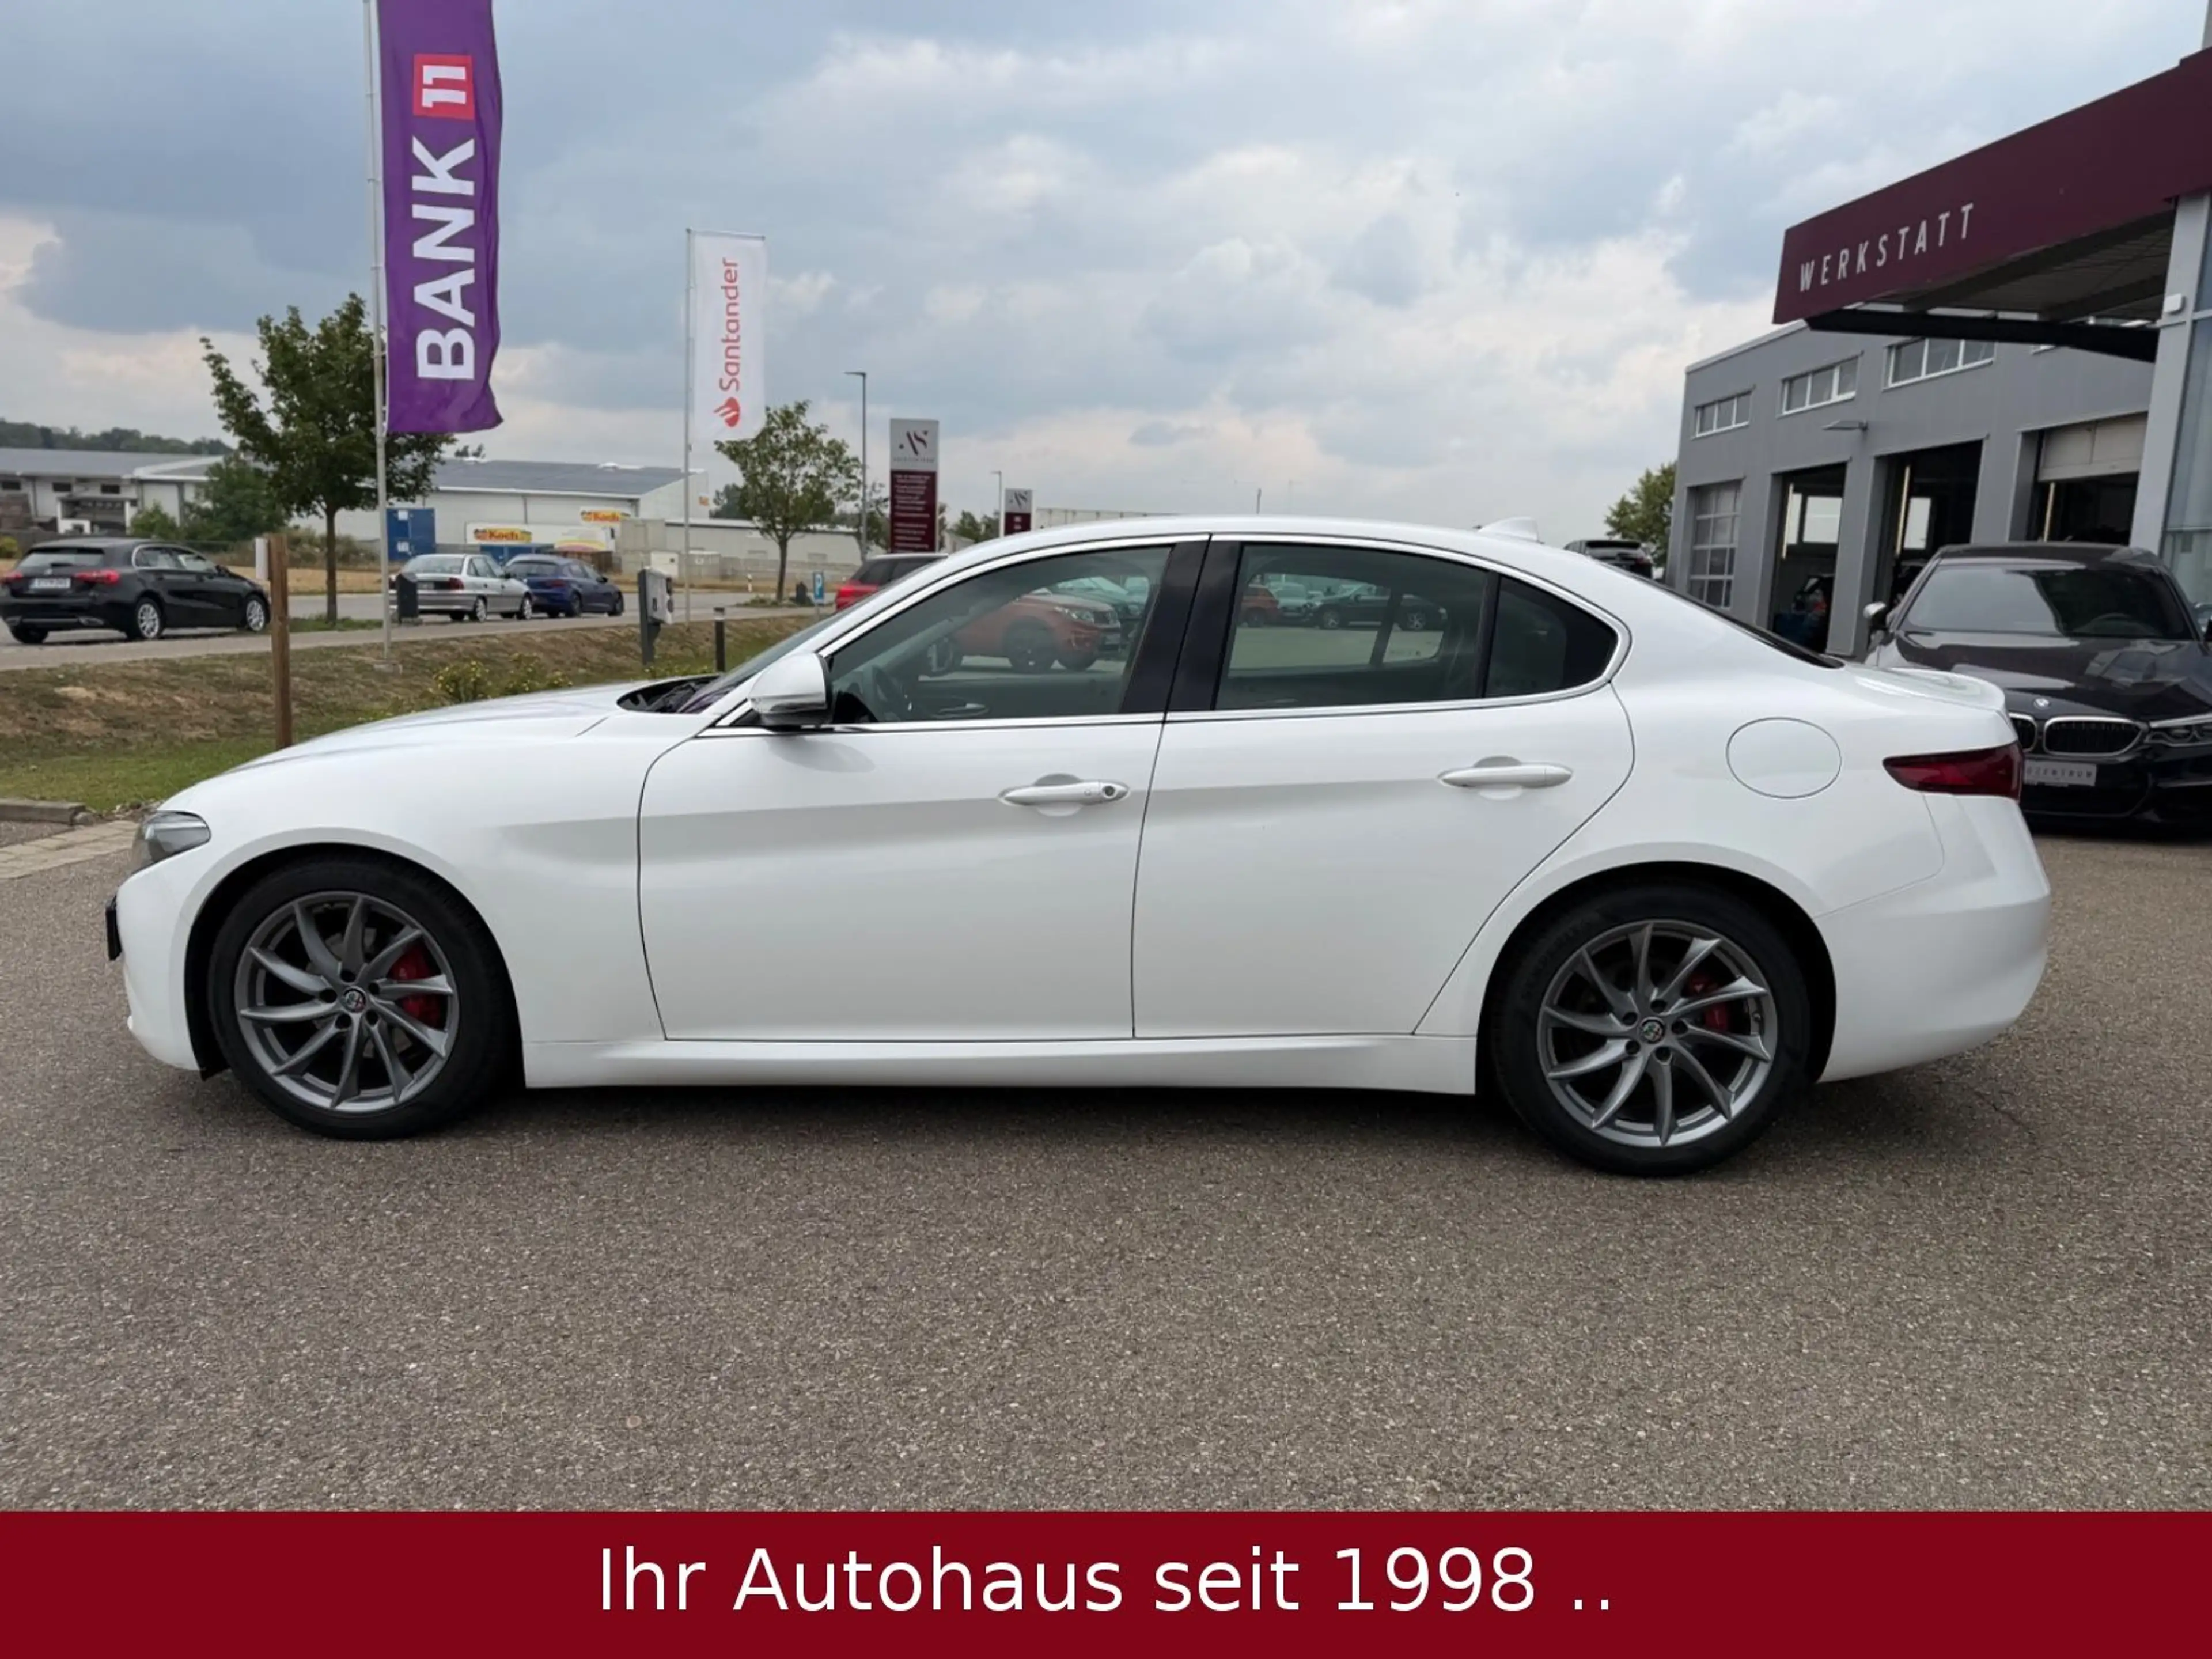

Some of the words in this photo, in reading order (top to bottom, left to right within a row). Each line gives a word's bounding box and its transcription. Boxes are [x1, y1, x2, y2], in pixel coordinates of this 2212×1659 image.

[422, 65, 466, 108] 11
[412, 136, 474, 380] BANK
[1800, 202, 1974, 292] WERKSTATT
[719, 257, 741, 392] Santander
